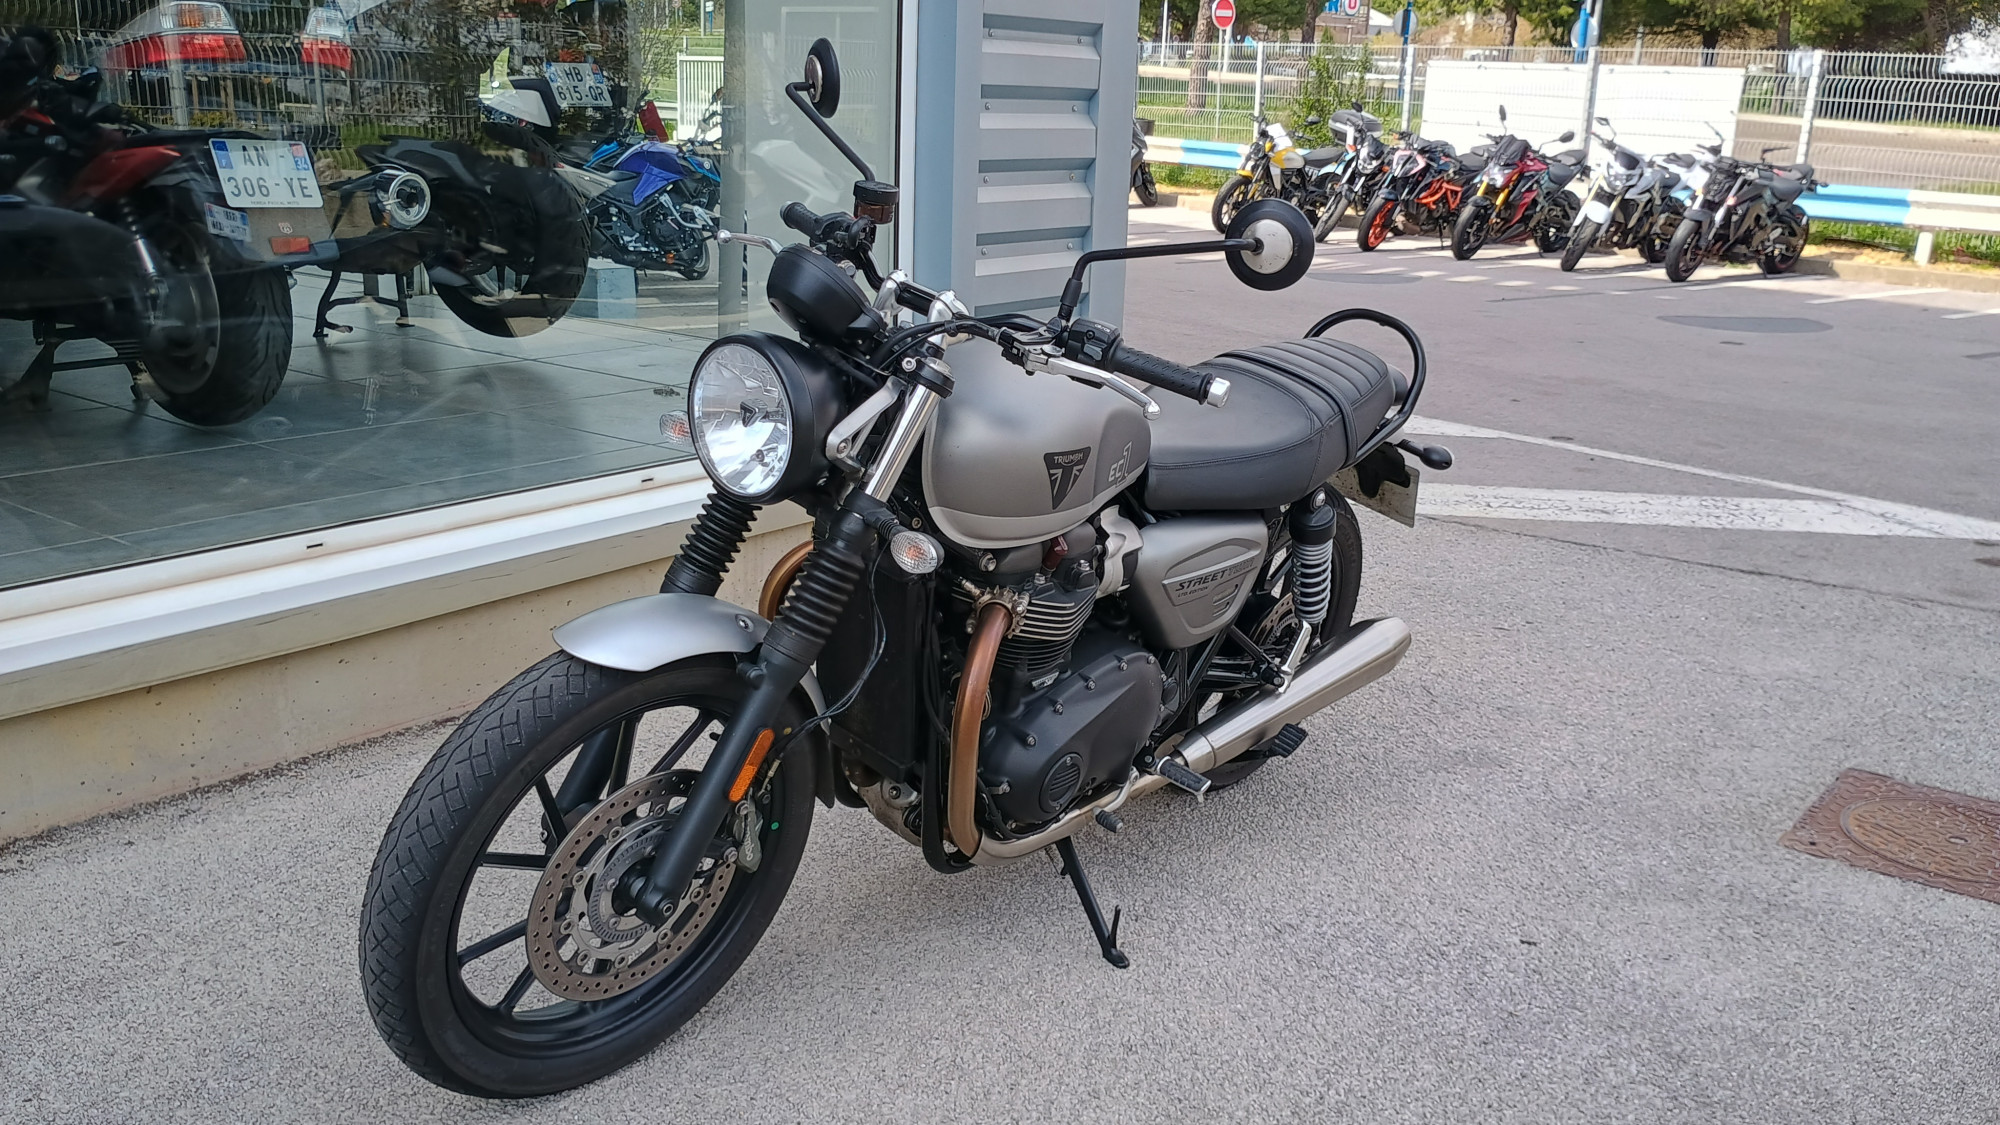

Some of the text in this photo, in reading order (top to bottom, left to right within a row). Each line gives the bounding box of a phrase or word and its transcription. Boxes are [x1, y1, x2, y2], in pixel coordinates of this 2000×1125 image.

[227, 176, 313, 198] 306-YE
[1053, 452, 1084, 464] TRIUMPH
[1175, 569, 1229, 592] STREET
